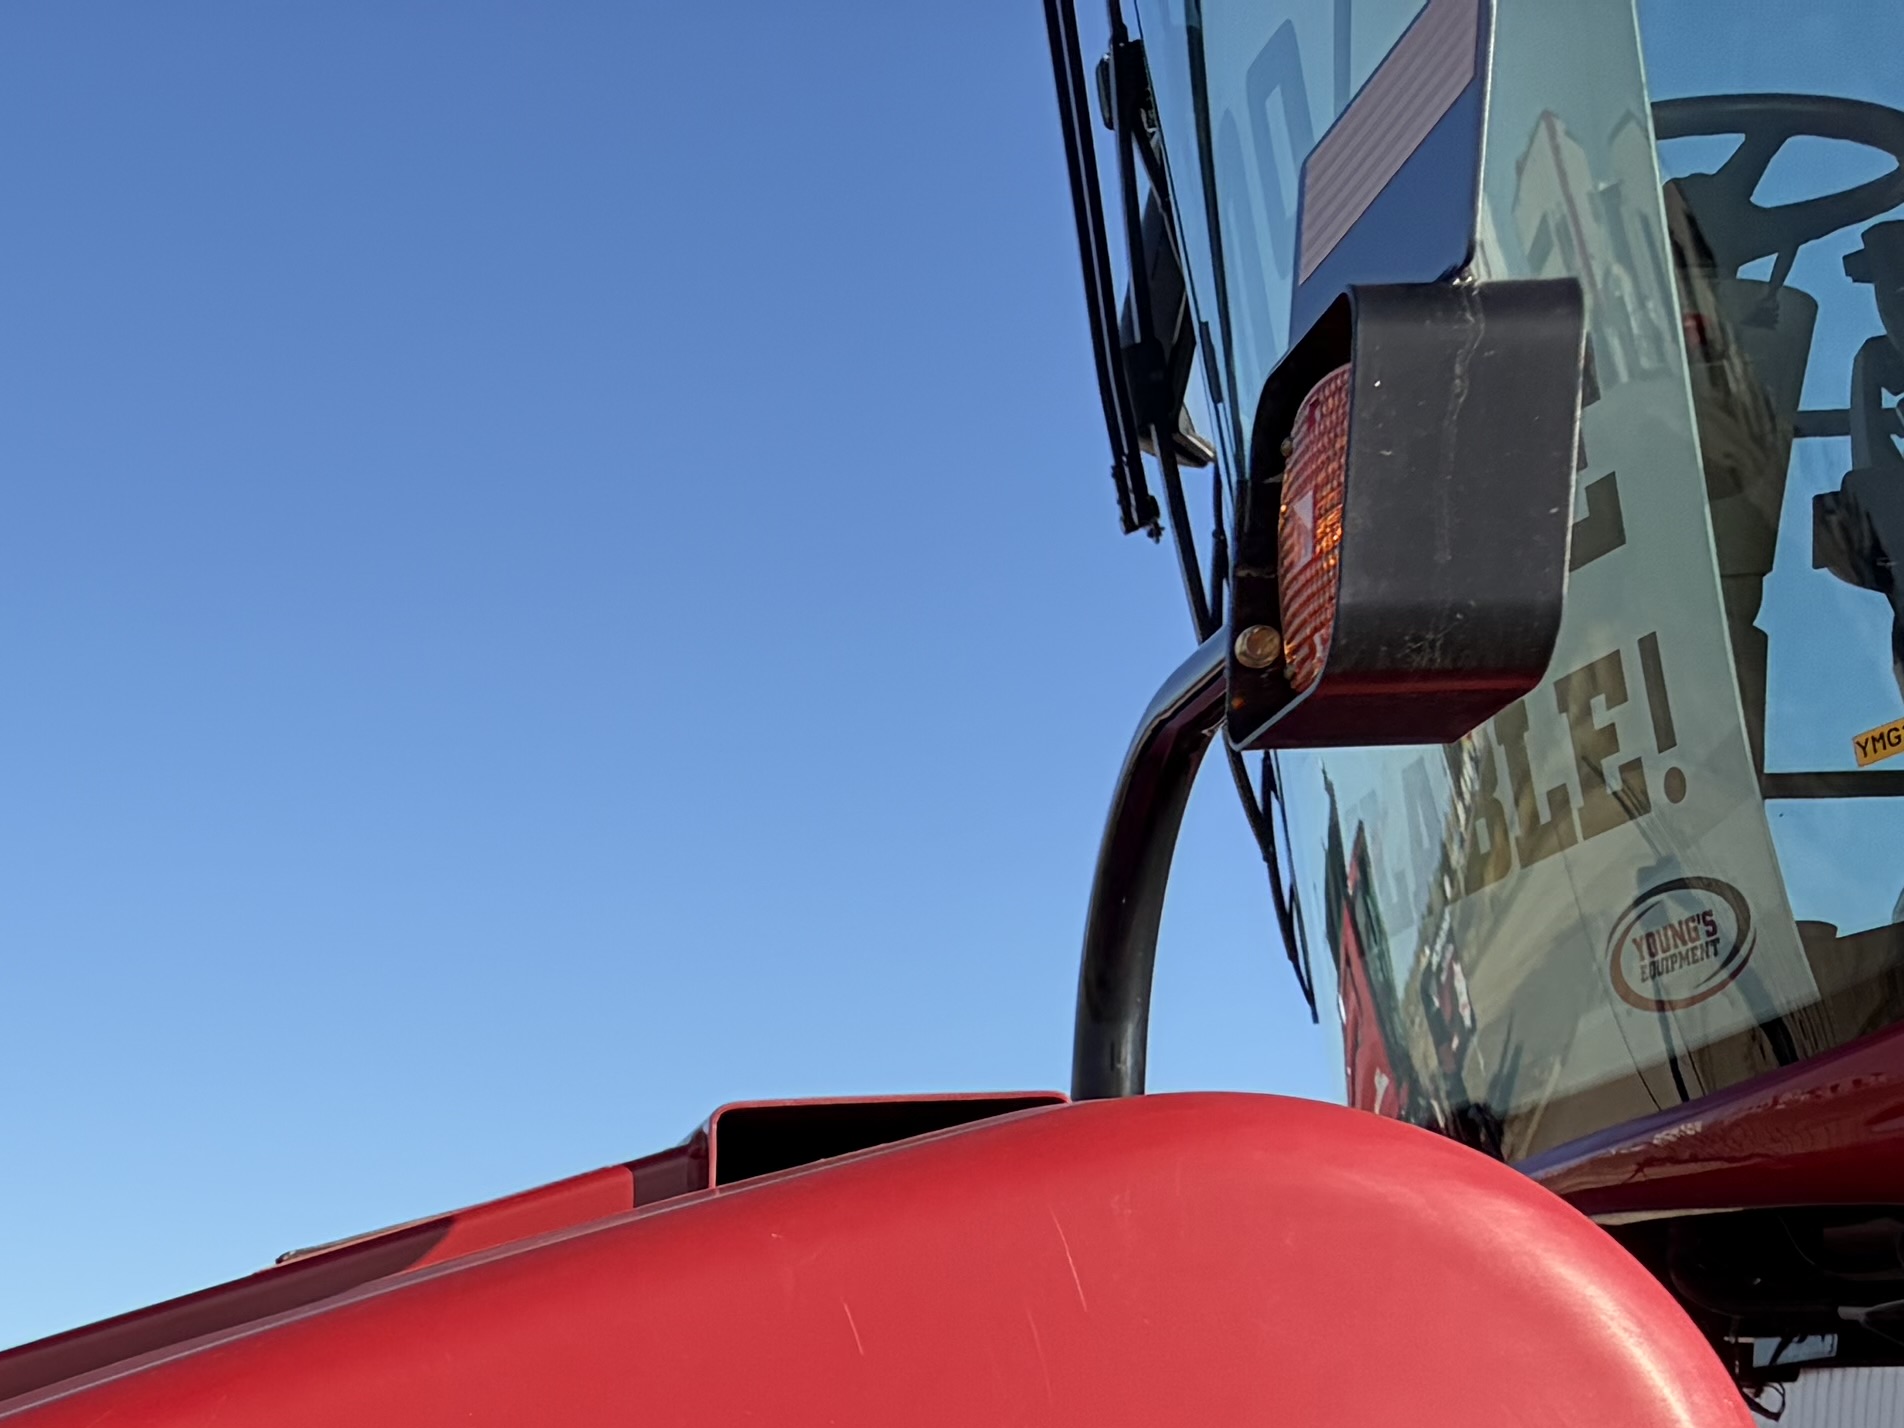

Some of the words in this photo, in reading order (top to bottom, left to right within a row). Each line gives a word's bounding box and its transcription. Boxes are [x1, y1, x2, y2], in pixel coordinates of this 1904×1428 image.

[1856, 725, 1904, 758] YMG
[1632, 909, 1718, 961] YOUNG'S
[1640, 937, 1720, 983] EQUIPMENT
